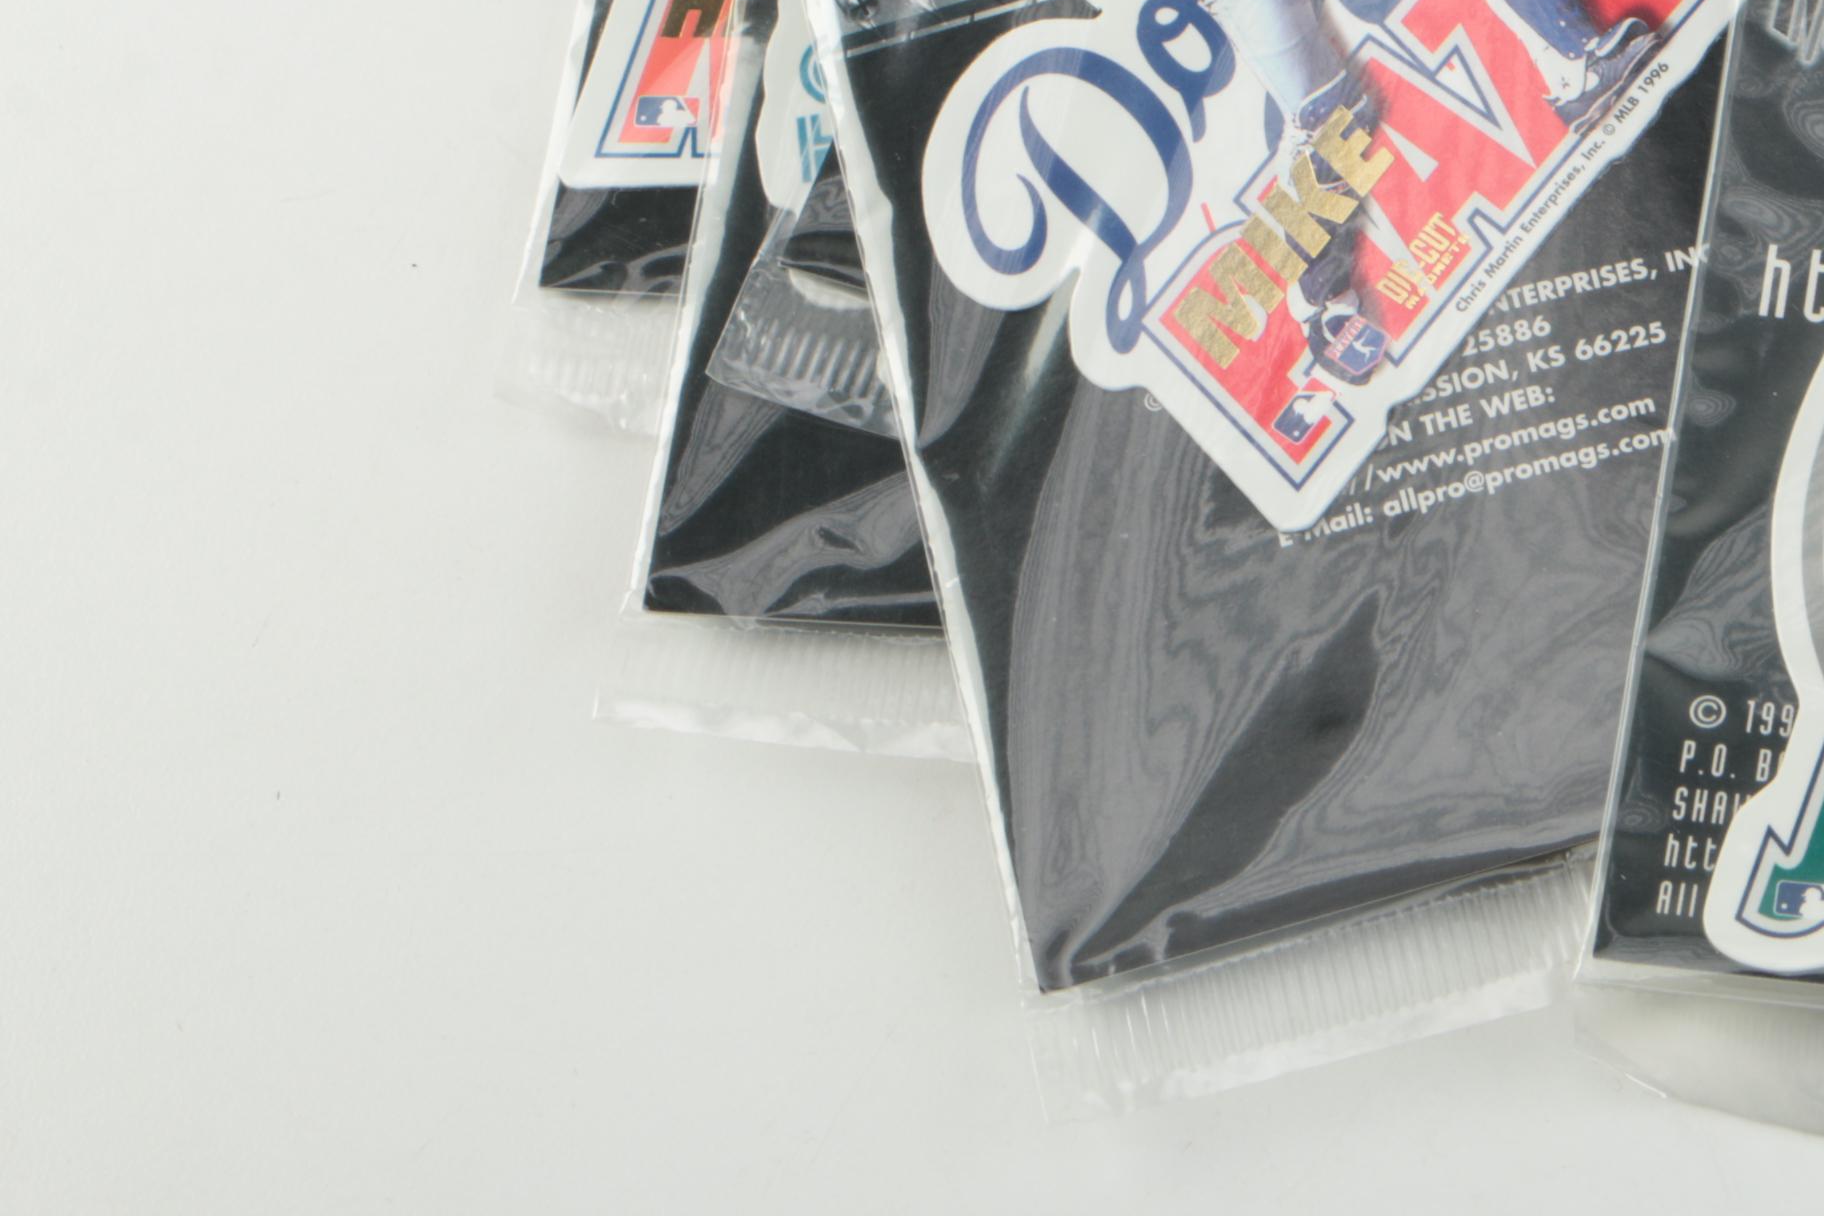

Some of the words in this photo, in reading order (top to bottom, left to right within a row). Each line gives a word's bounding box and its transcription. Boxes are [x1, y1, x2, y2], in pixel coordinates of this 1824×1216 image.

[1455, 279, 1487, 313] Chris
[1483, 233, 1524, 279] Martin
[1519, 163, 1587, 235] Enterprises,
[1580, 138, 1606, 162] Inc.
[1614, 95, 1640, 124] MLB
[1637, 61, 1670, 95] 1996
[1173, 104, 1396, 370] MIKE
[1489, 257, 1658, 317] NTERPRISES,
[1408, 359, 1520, 405] SSION,
[1526, 345, 1567, 373] KS
[1574, 321, 1667, 362] 66225
[1419, 403, 1474, 436] THE
[1479, 384, 1556, 419] WEB:
[1382, 426, 1678, 514] allpro@promags.com
[1679, 739, 1736, 780] P.O.
